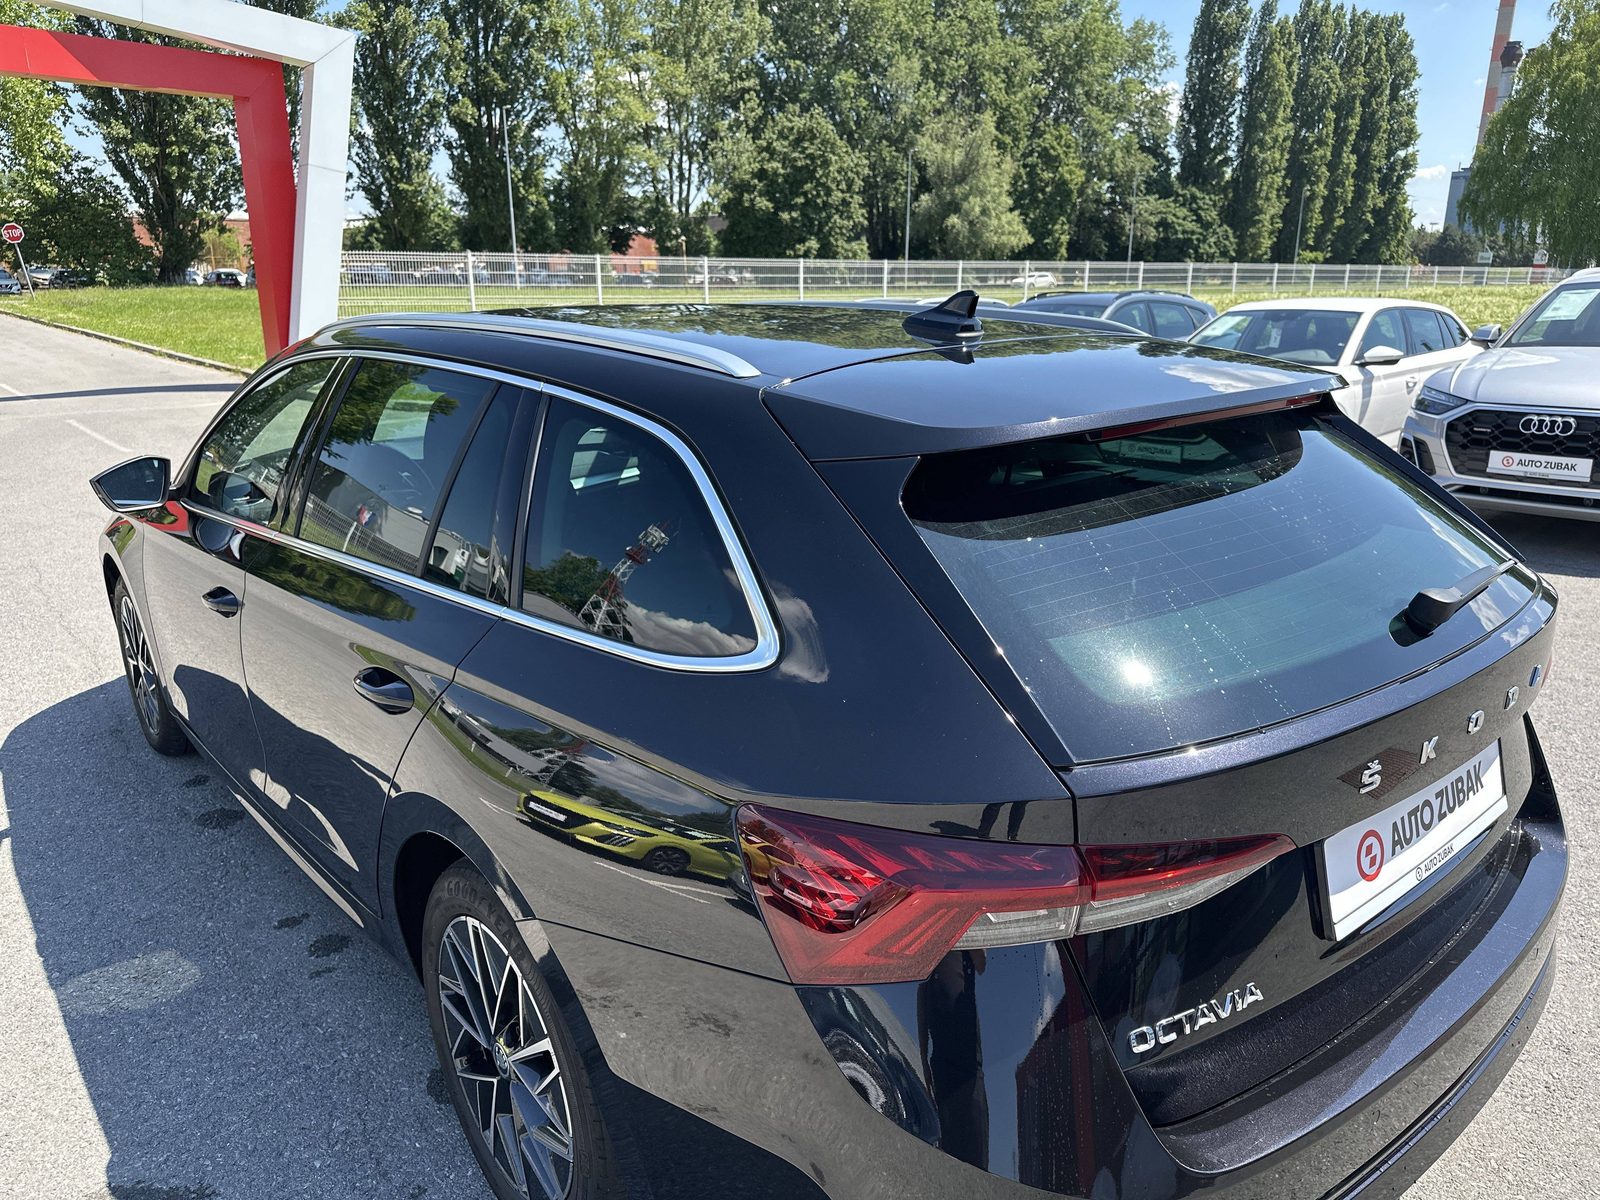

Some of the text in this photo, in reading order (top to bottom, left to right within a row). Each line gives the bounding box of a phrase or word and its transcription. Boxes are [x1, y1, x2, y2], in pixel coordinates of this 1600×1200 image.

[4, 229, 21, 238] STOP
[1516, 458, 1578, 472] AUTO ZUBAK
[1391, 760, 1484, 857] AUTO ZUBAK
[1424, 843, 1455, 874] AUTO ZUBAK
[1128, 982, 1264, 1054] OCTAVIA
